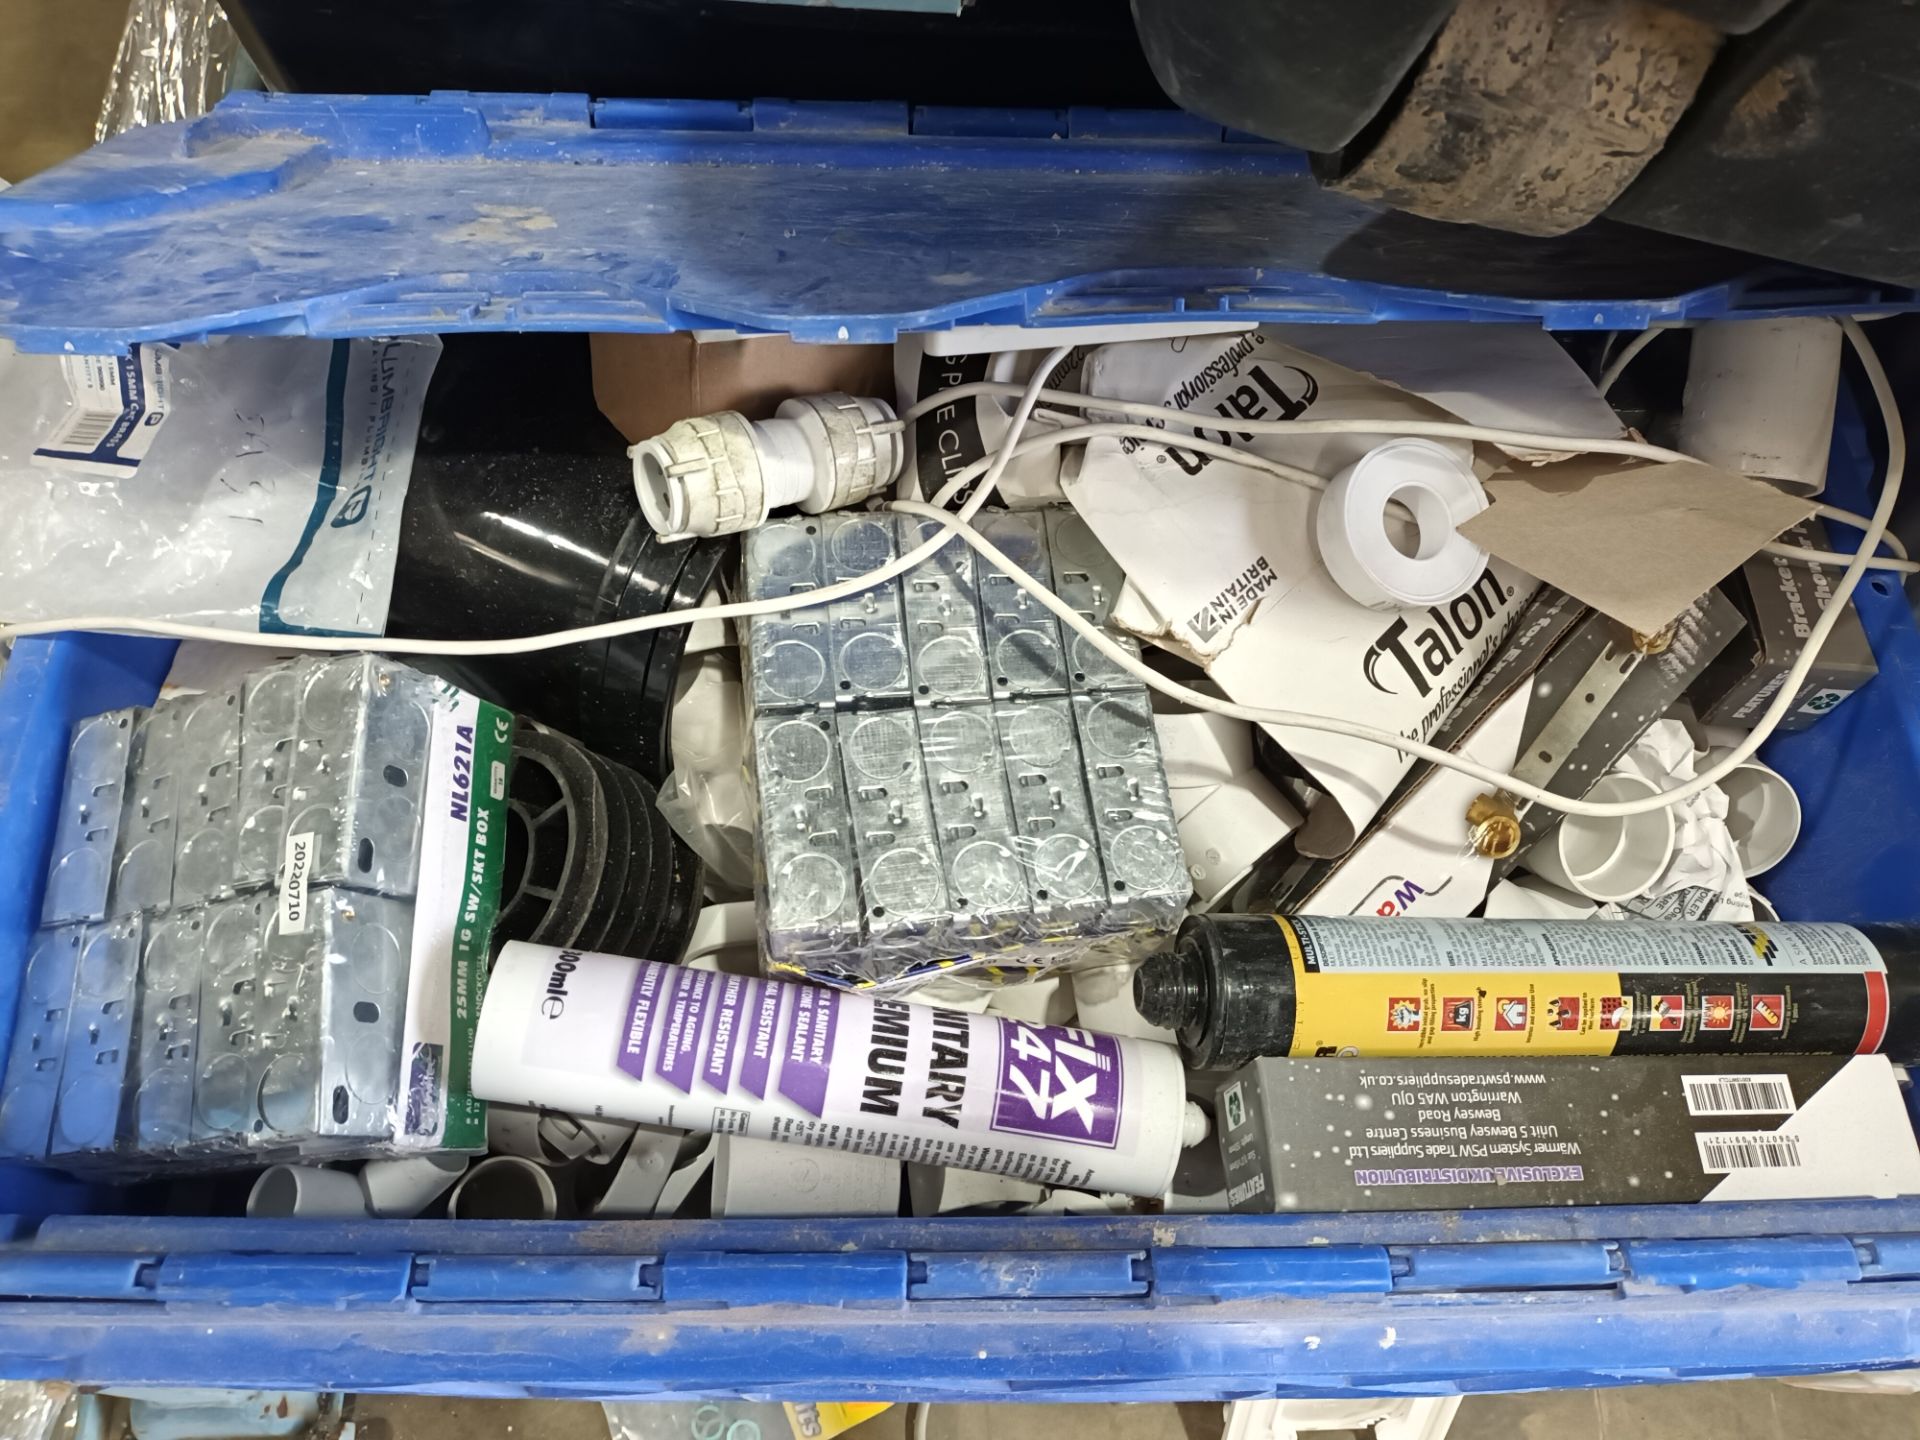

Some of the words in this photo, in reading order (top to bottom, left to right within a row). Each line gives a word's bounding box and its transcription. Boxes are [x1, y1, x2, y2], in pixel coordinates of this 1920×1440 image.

[126, 365, 138, 400] 15MM
[106, 421, 130, 448] BRASS
[1209, 555, 1270, 613] BRITAIN
[1236, 568, 1278, 610] MADE
[1773, 556, 1811, 638] Bracket
[1218, 604, 1238, 625] IN
[1374, 567, 1508, 698] Talon
[450, 724, 473, 822] NL621A
[475, 806, 490, 847] BOX
[288, 841, 306, 922] 20220710
[464, 848, 487, 924] SW/SKT
[459, 928, 472, 952] 1G
[1541, 933, 1561, 967] APPLICATION
[1730, 938, 1747, 966] COVERAGE
[1446, 950, 1456, 967] USES
[1692, 941, 1707, 966] STORAGE
[1725, 948, 1738, 966] SHELF
[456, 959, 469, 1020] 25MM
[690, 1001, 700, 1013] TO
[1456, 1006, 1469, 1023] kg
[626, 999, 651, 1054] FLEXIBLE
[662, 999, 687, 1073] TEMPERATURES
[679, 1015, 697, 1055] AGEING,
[752, 998, 778, 1059] RESISTANT
[790, 1011, 811, 1064] SEALANT
[810, 1008, 829, 1065] SANITARY
[710, 1009, 734, 1076] RESISTANT
[1359, 1071, 1546, 1088] www.pswtradesuppliers.co.uk
[1417, 1092, 1449, 1105] WA5
[1451, 1088, 1522, 1104] Warrington
[1418, 1109, 1452, 1122] Road
[1453, 1106, 1502, 1121] Bewsey
[1365, 1127, 1408, 1141] Centre
[1410, 1126, 1468, 1140] Business
[1470, 1124, 1518, 1139] Bewsey
[1530, 1125, 1559, 1139] Unit
[1349, 1146, 1369, 1159] Ltd
[1370, 1142, 1424, 1159] Suppliers
[1424, 1145, 1458, 1158] Trade
[1459, 1144, 1488, 1158] PSW
[1489, 1140, 1532, 1156] System
[1494, 1165, 1584, 1183] EXCLUSIVE
